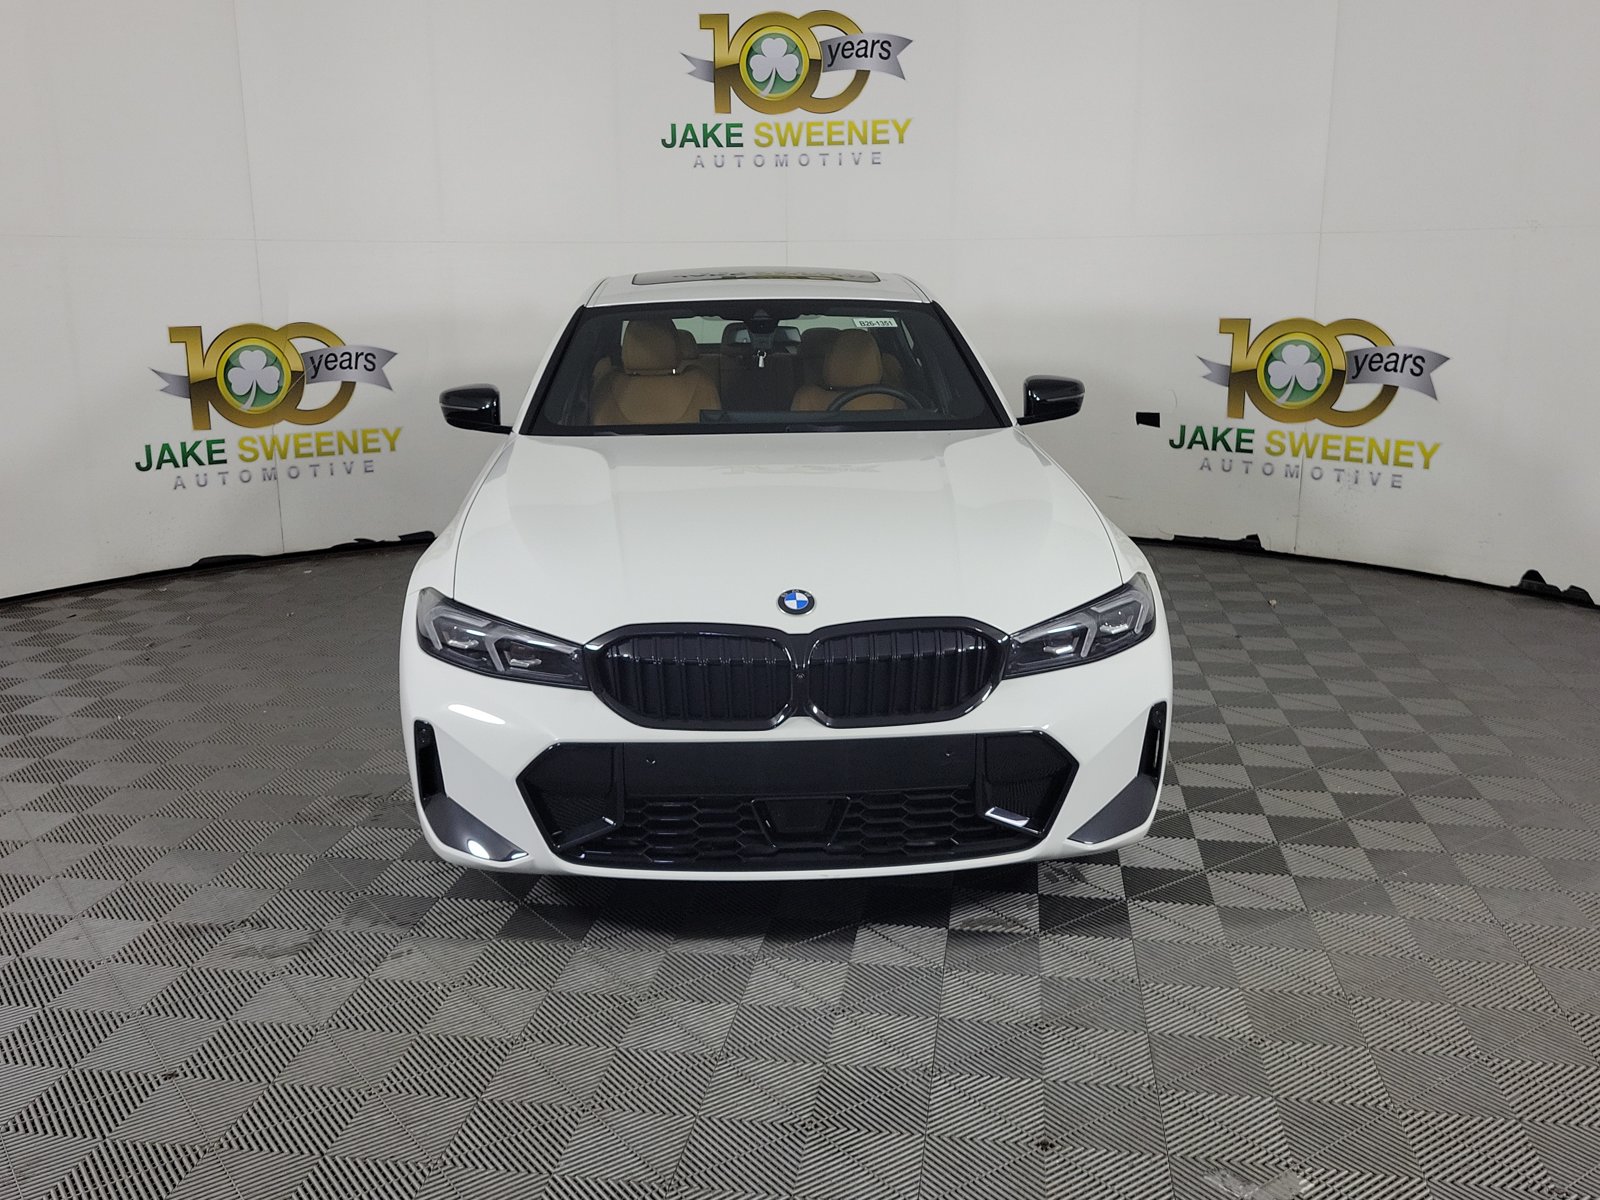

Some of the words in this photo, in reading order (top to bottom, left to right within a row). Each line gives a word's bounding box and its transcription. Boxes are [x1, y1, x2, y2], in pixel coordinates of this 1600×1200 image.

[699, 10, 871, 115] 100
[827, 38, 893, 68] years
[661, 123, 744, 149] JAKE
[754, 118, 913, 148] SWEENEY
[693, 152, 882, 168] AUTOMOTIVE
[168, 322, 357, 430] 100
[309, 351, 377, 379] years
[1219, 317, 1400, 427] 100
[1351, 352, 1426, 379] years
[134, 439, 228, 472] JAKE
[237, 427, 403, 463] SWEENEY
[1169, 424, 1255, 454] JAKE
[1264, 429, 1441, 470] SWEENEY
[173, 460, 375, 490] AUTOMOTIVE
[1200, 457, 1403, 489] AUTOMOTIVE
